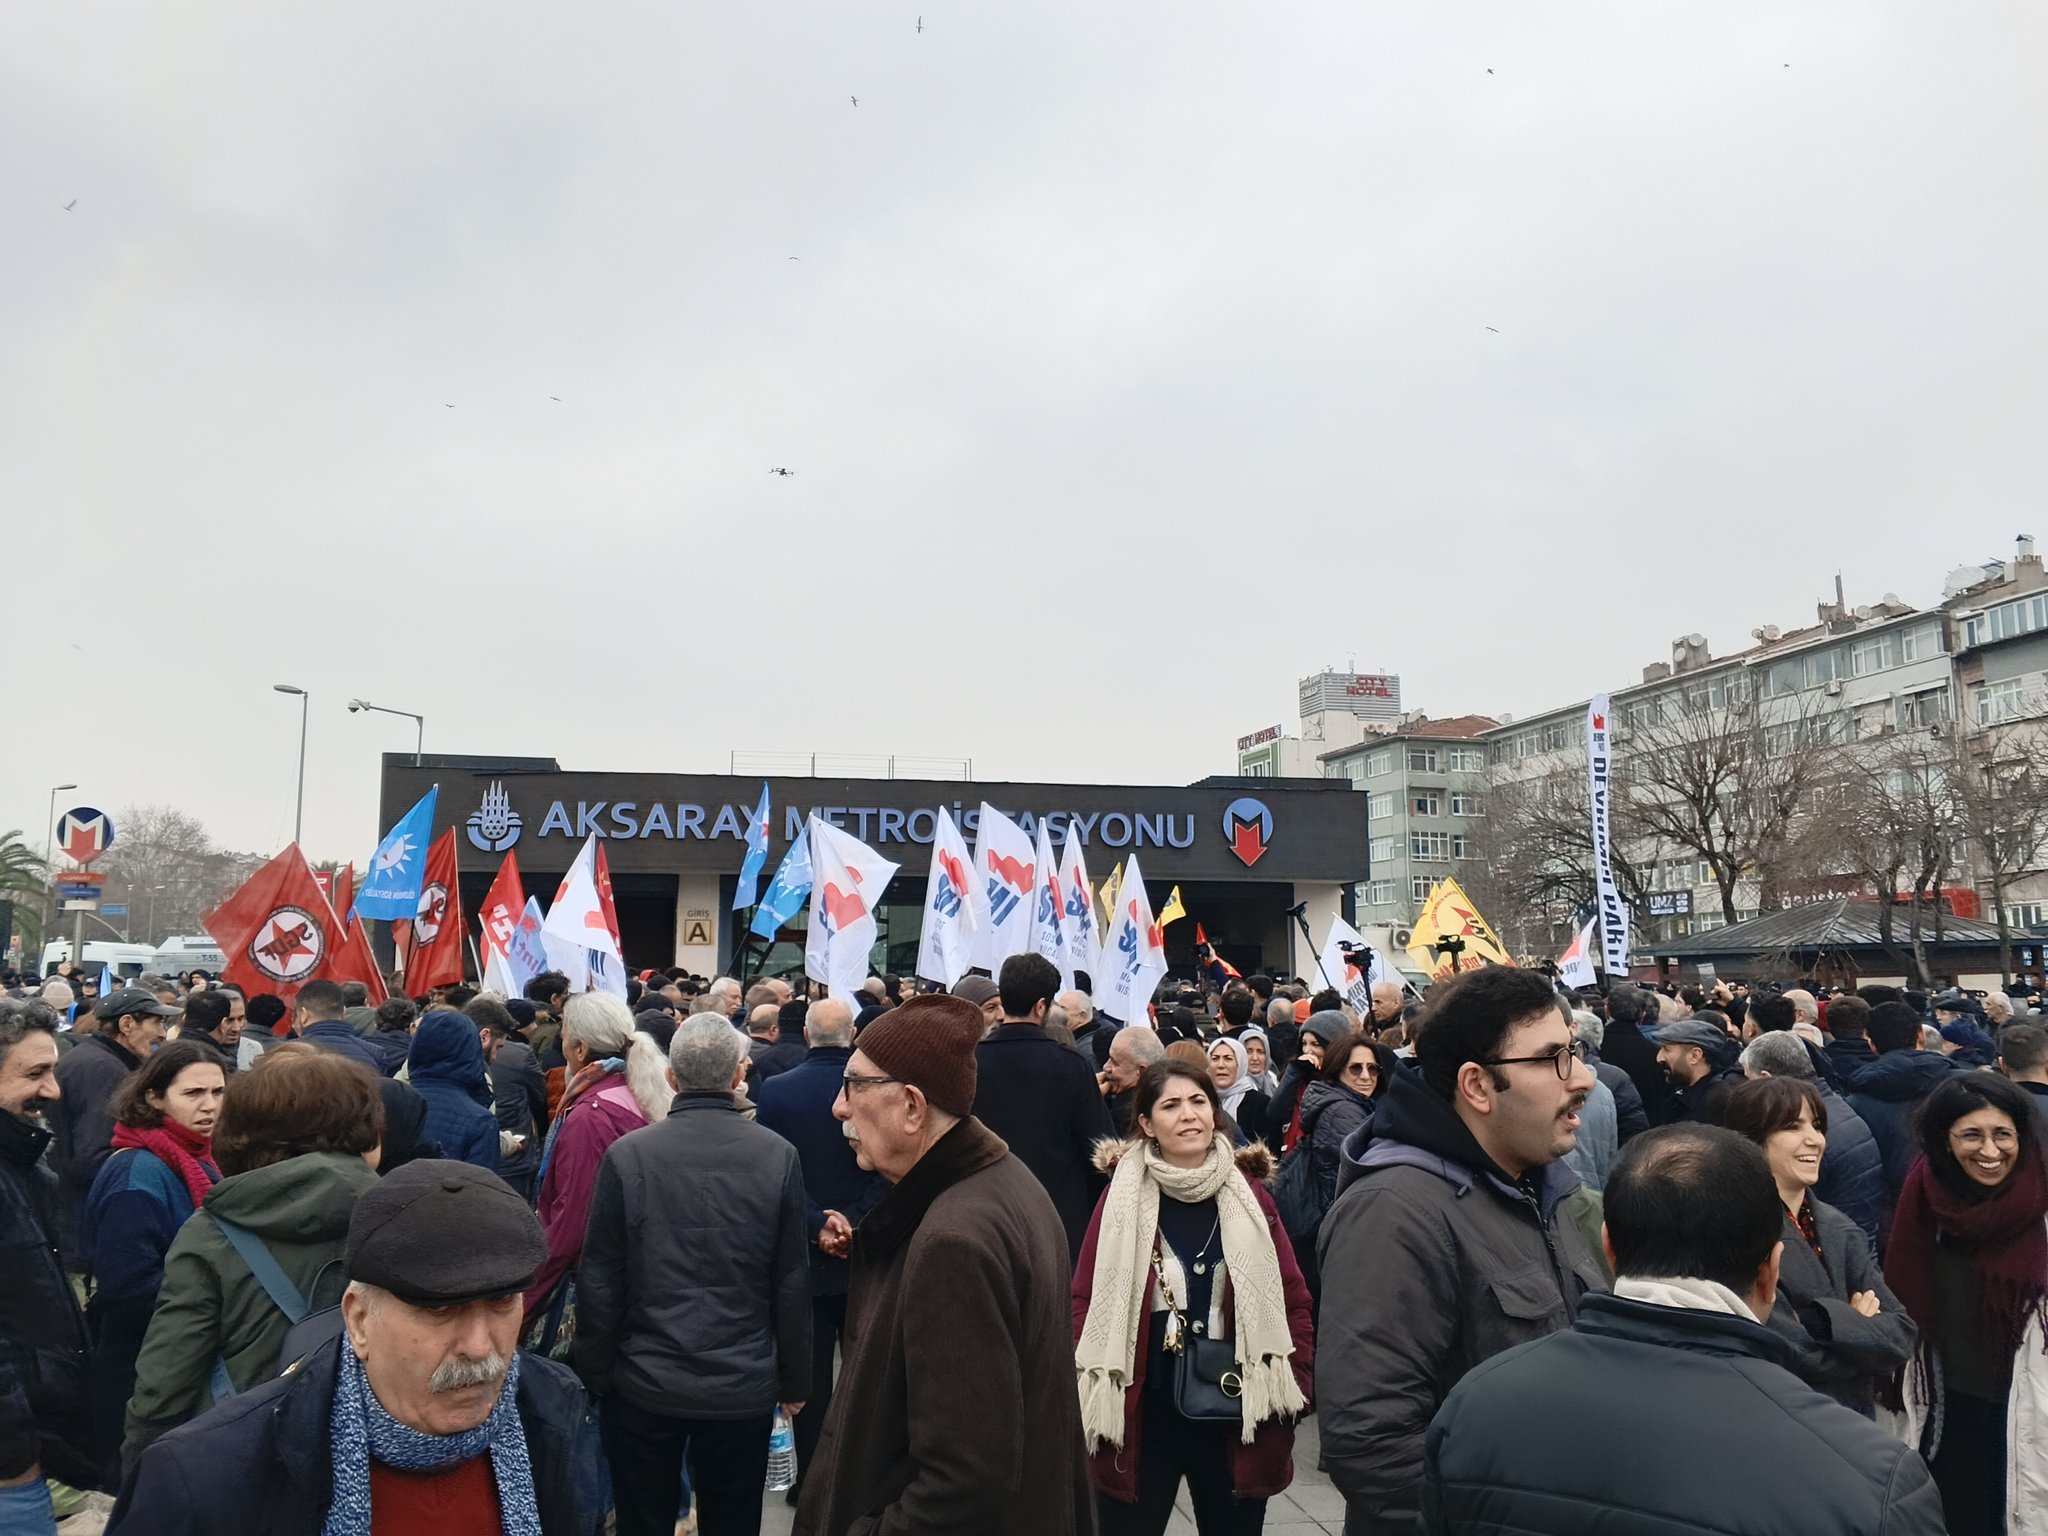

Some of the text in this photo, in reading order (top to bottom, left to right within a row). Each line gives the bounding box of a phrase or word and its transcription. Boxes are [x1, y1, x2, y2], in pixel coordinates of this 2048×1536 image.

[1356, 676, 1387, 687] CITY
[1346, 686, 1393, 697] HOTEL
[785, 806, 938, 845] METRO
[687, 907, 710, 919] GİRİŞ
[688, 921, 707, 942] A
[202, 954, 218, 962] T-55
